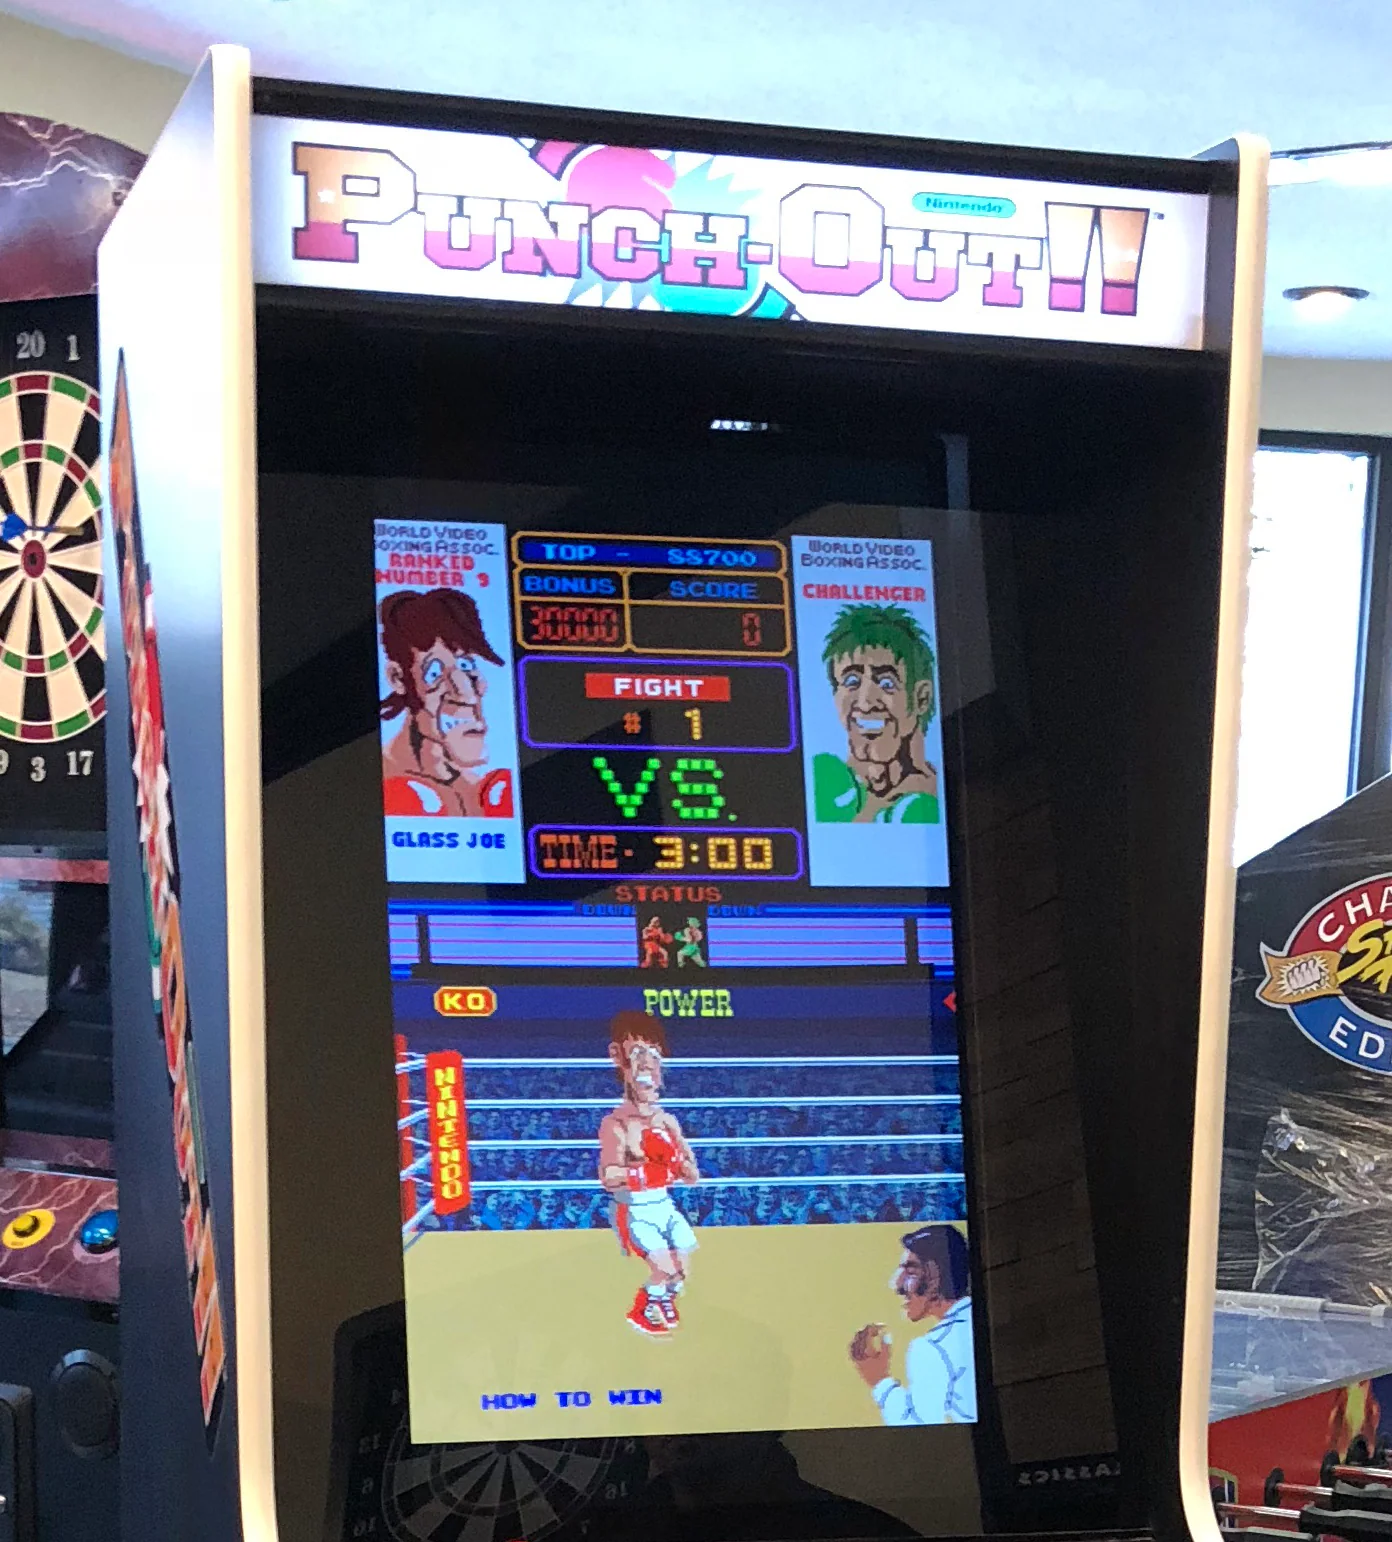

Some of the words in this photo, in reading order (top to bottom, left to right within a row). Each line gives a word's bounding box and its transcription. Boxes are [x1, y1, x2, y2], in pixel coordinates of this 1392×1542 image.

[924, 196, 1005, 215] Nintendo
[291, 140, 1151, 317] PUNCH-OUT!!
[16, 330, 46, 359] 20
[66, 334, 80, 361] 1
[375, 524, 432, 539] WORLD
[434, 526, 488, 541] VIDEO
[374, 540, 432, 553] OXING
[435, 541, 500, 555] ASSOC.
[542, 543, 596, 562] TOP
[667, 548, 757, 567] 88700
[808, 540, 863, 555] WORLD
[865, 542, 916, 557] VIDEO
[389, 553, 475, 571] RANKED
[801, 553, 864, 569] BOXING
[866, 555, 928, 571] ASSOC.
[375, 568, 465, 587] NUMBER
[476, 572, 489, 588] 9
[523, 575, 617, 595] BONUS
[669, 580, 758, 600] SCORE
[802, 583, 926, 603] CHALLENGER
[530, 605, 620, 643] 30000
[742, 612, 762, 647] 0
[613, 677, 705, 698] FIGHT
[684, 708, 703, 741] 1
[30, 756, 47, 782] 3
[66, 750, 94, 776] 17
[592, 756, 738, 821] VS.
[392, 831, 459, 849] GLASS
[466, 832, 506, 849] JOE
[652, 836, 773, 871] 3:00
[615, 884, 723, 903] STATUS
[443, 992, 486, 1011] KO
[643, 988, 735, 1018] POWER
[433, 1066, 463, 1200] NINTENDO
[481, 1392, 537, 1411] HOW
[554, 1390, 592, 1408] TO
[608, 1388, 663, 1405] WIN
